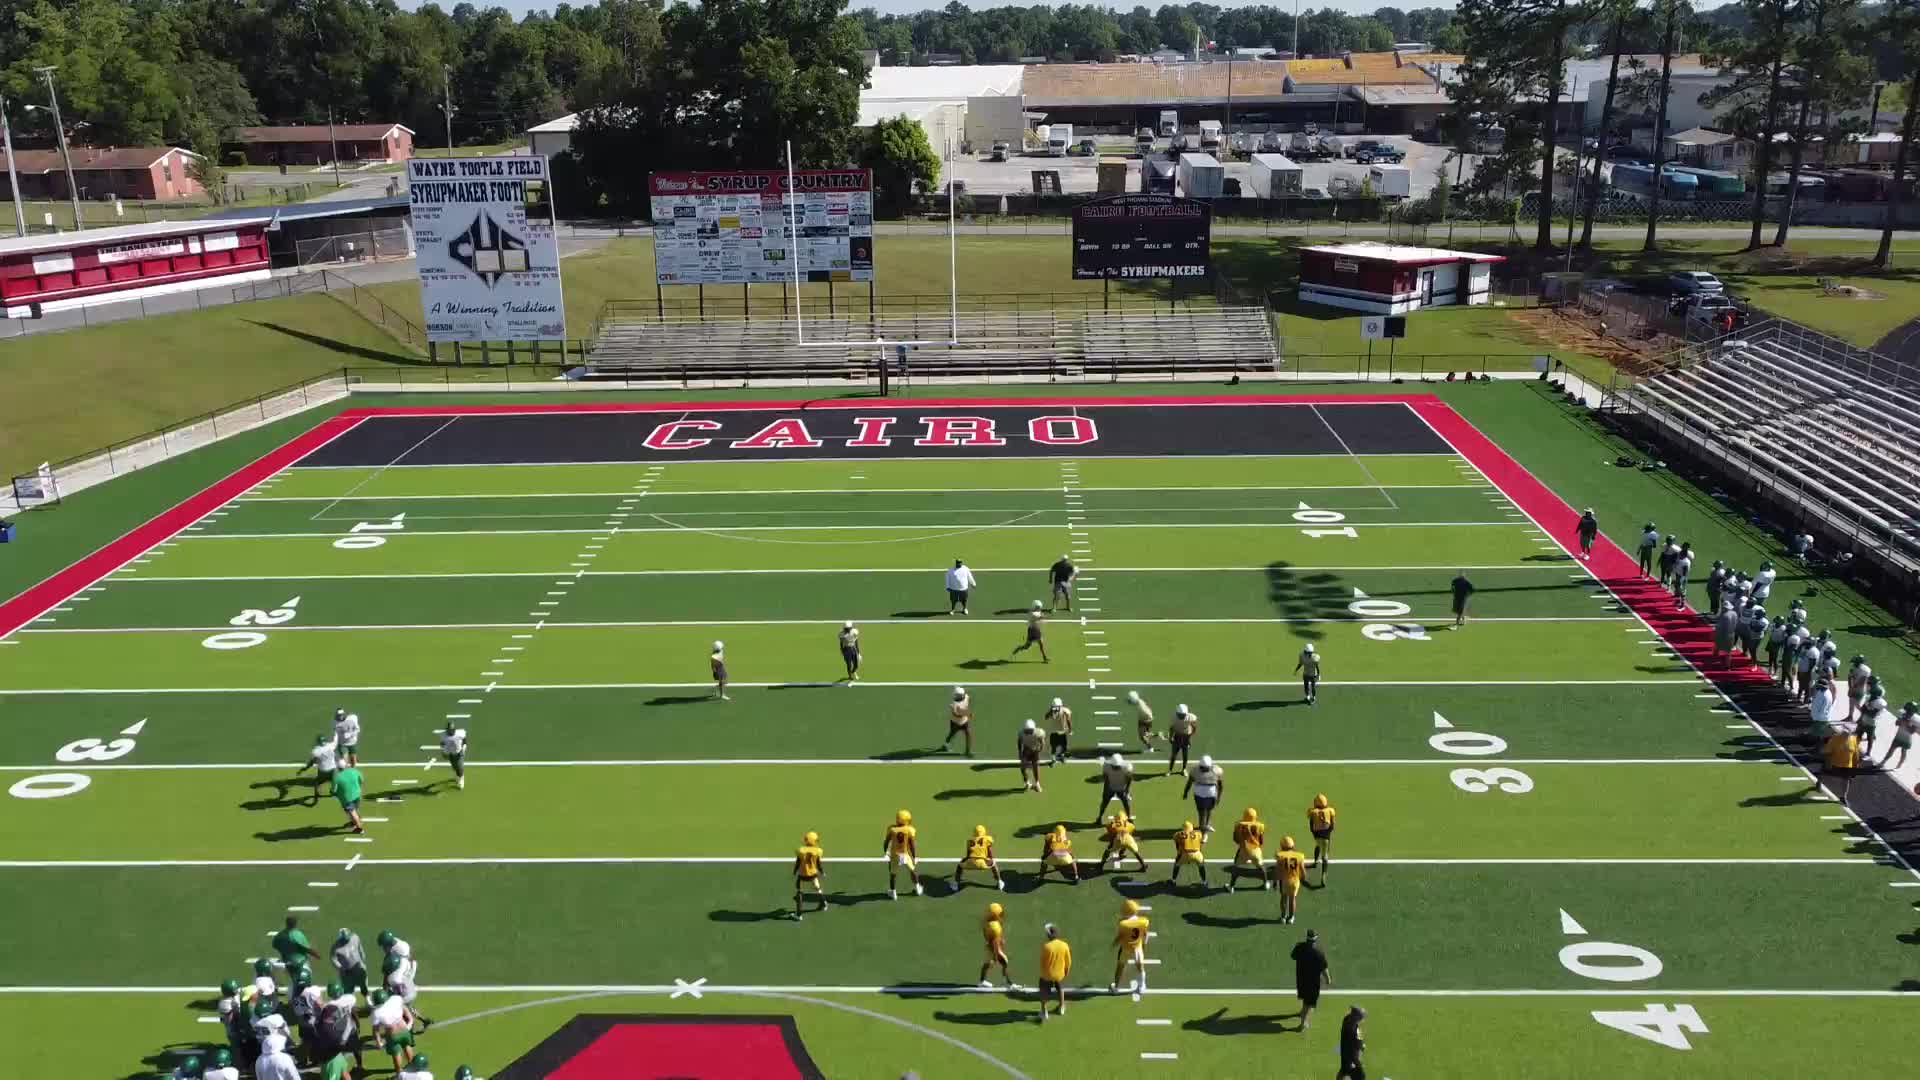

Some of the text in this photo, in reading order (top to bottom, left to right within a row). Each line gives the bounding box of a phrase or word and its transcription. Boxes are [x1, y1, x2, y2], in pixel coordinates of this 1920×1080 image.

[413, 160, 541, 176] WAYNE TOOTLE FIELD
[410, 183, 489, 203] SYRUPMAKER
[707, 175, 771, 191] SYRUP
[777, 174, 865, 190] COUNTRY
[1082, 204, 1202, 217] CAIRO FOOTBALL
[1121, 265, 1205, 277] SYRUPMAKERS
[431, 301, 556, 317] A Winning Tradition
[641, 415, 1099, 450] CAIRO
[333, 521, 404, 549] 10
[1292, 510, 1358, 538] 10
[202, 608, 297, 650] 20
[1349, 599, 1432, 641] 20
[8, 738, 136, 799] 30
[1428, 731, 1534, 794] 30
[1558, 941, 1710, 1050] 40
